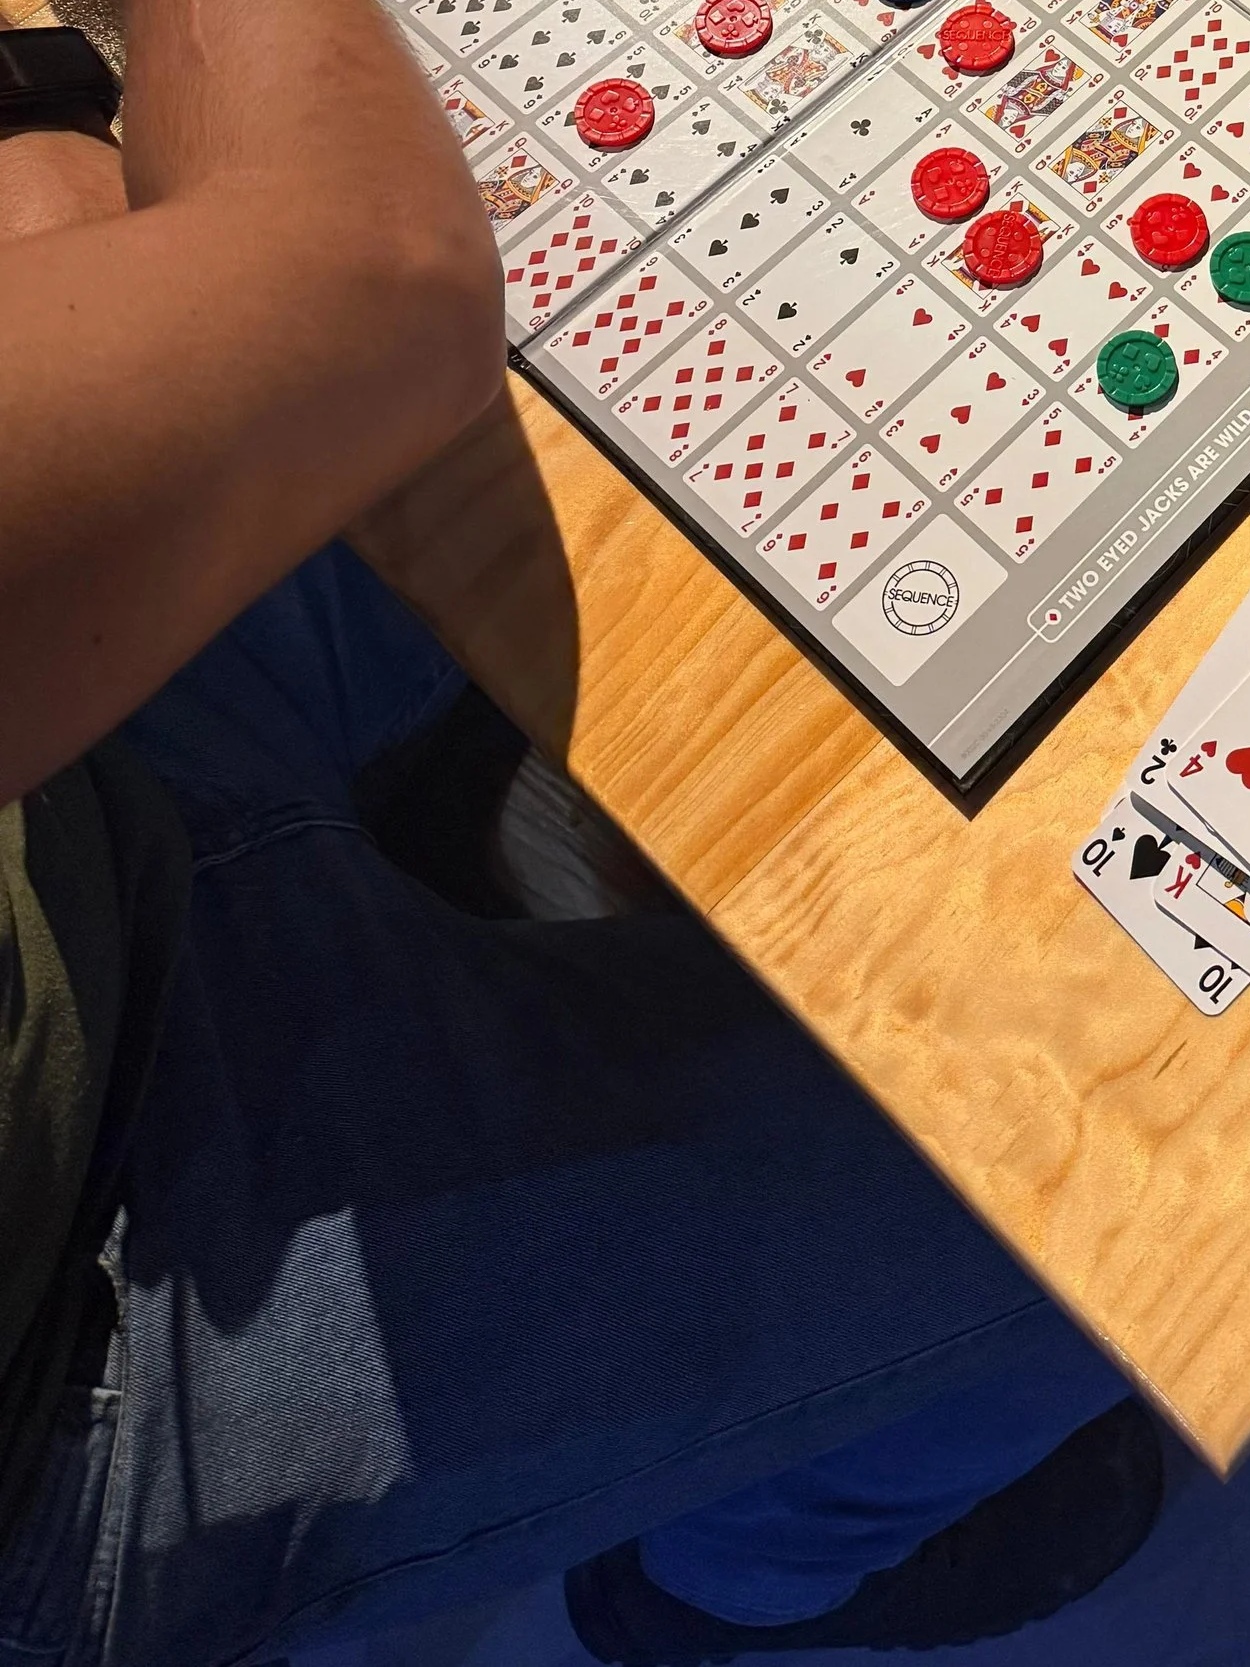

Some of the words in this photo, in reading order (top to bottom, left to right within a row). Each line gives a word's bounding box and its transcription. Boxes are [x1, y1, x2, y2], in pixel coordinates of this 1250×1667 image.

[415, 5, 428, 14] 7
[943, 28, 1011, 43] SEQUENCE
[460, 44, 472, 54] 7
[1207, 125, 1218, 135] 6
[1011, 181, 1023, 193] K
[1061, 224, 1074, 236] K
[1083, 243, 1094, 252] 4
[881, 261, 894, 272] 2
[927, 255, 940, 267] K
[1136, 287, 1147, 296] 4
[1180, 280, 1192, 291] 3
[742, 294, 755, 306] 2
[978, 299, 991, 312] K
[715, 319, 727, 330] 8
[1000, 319, 1011, 328] 4
[1234, 325, 1246, 336] 3
[793, 340, 806, 351] 2
[974, 342, 987, 354] 3
[765, 365, 778, 376] 8
[1053, 364, 1064, 374] 4
[786, 383, 799, 394] 7
[1027, 389, 1039, 400] 3
[618, 401, 632, 413] 8
[1049, 408, 1062, 419] 5
[838, 430, 851, 442] 7
[886, 425, 898, 437] 3
[669, 450, 682, 462] 8
[859, 451, 871, 462] 6
[1104, 456, 1116, 468] 5
[689, 471, 703, 482] 7
[939, 474, 952, 486] 3
[912, 500, 925, 512] 6
[960, 494, 973, 506] 5
[741, 520, 755, 533] 7
[1058, 569, 1100, 611] TWO
[1096, 528, 1139, 573] EYED
[1137, 476, 1190, 533] JACKS
[1186, 446, 1221, 483] ARE
[763, 539, 776, 552] 6
[1015, 545, 1028, 557] 5
[816, 591, 830, 604] 6
[888, 587, 954, 609] SEQUENCE
[1141, 755, 1166, 785] 2
[1179, 754, 1204, 778] 4
[1082, 839, 1115, 877] 10
[1164, 865, 1193, 899] K
[1200, 965, 1233, 1004] 10
